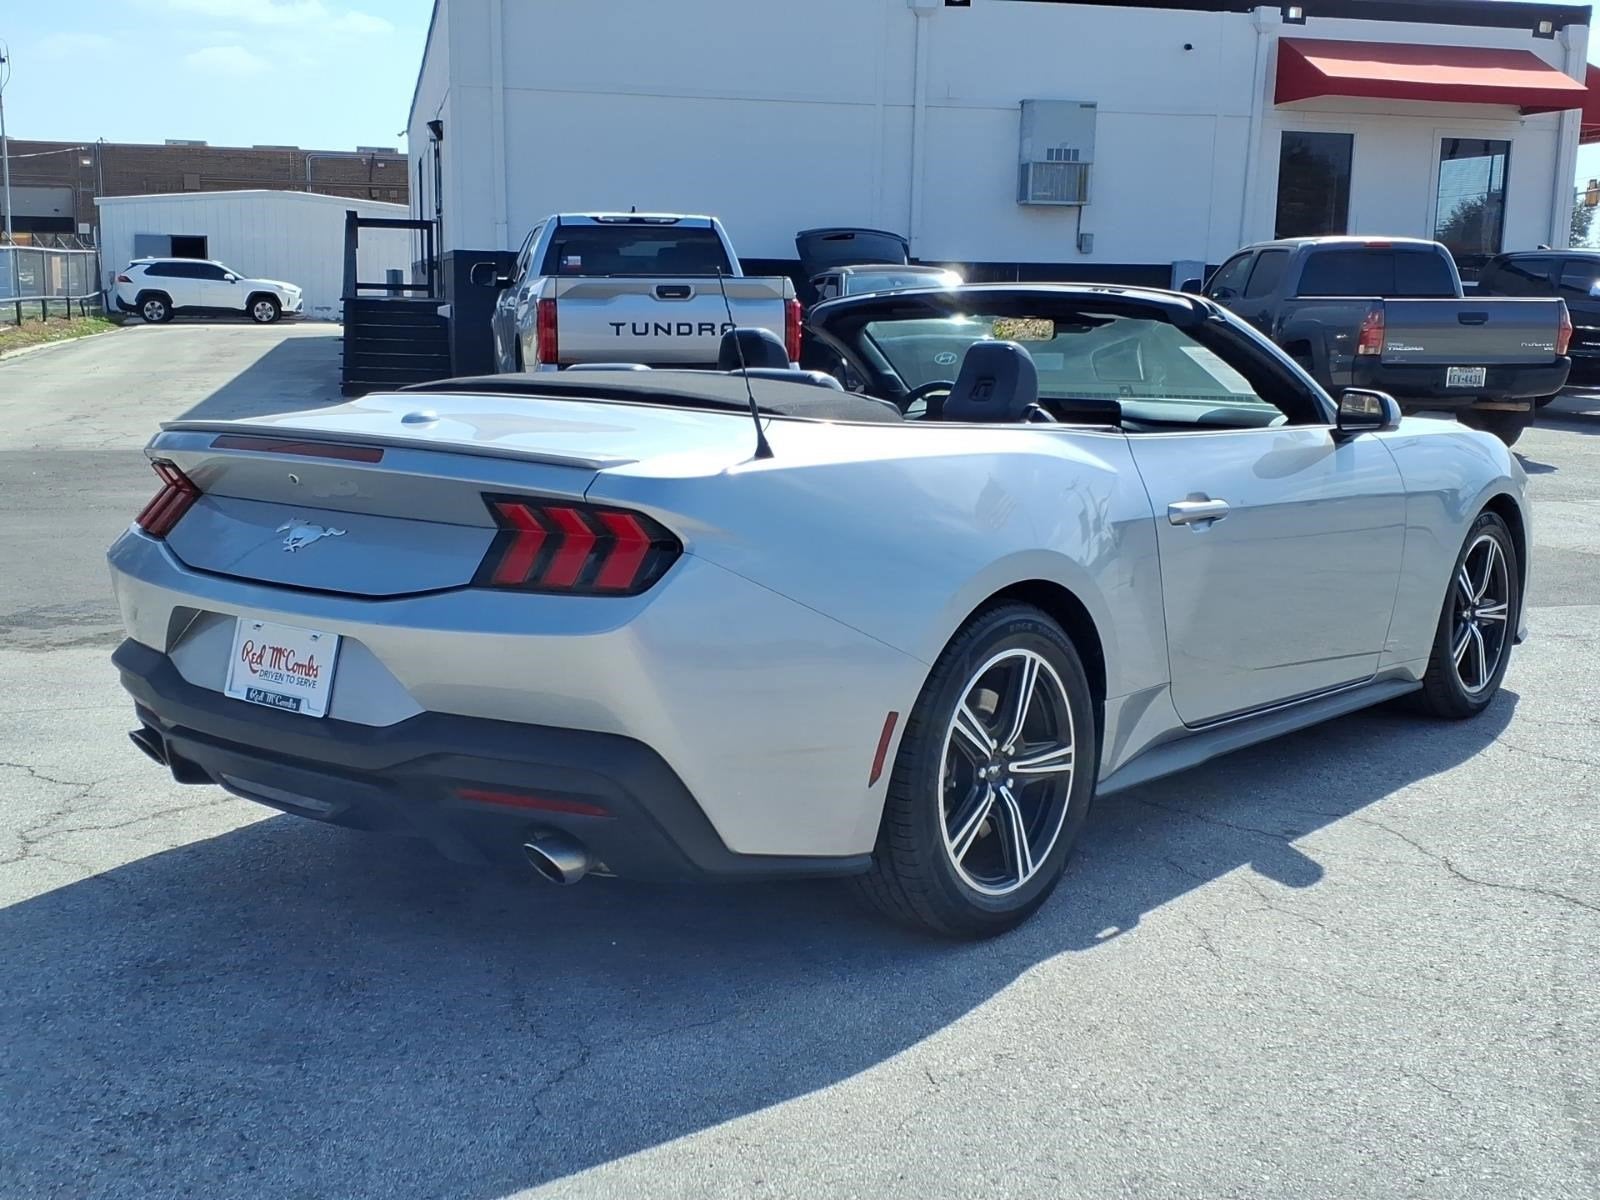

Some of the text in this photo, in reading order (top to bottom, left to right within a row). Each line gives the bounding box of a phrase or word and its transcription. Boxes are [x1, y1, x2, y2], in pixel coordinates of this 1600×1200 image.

[241, 639, 319, 679] Red McCombs
[259, 669, 317, 689] DRIVEN TO SERVE
[249, 688, 265, 703] Red
